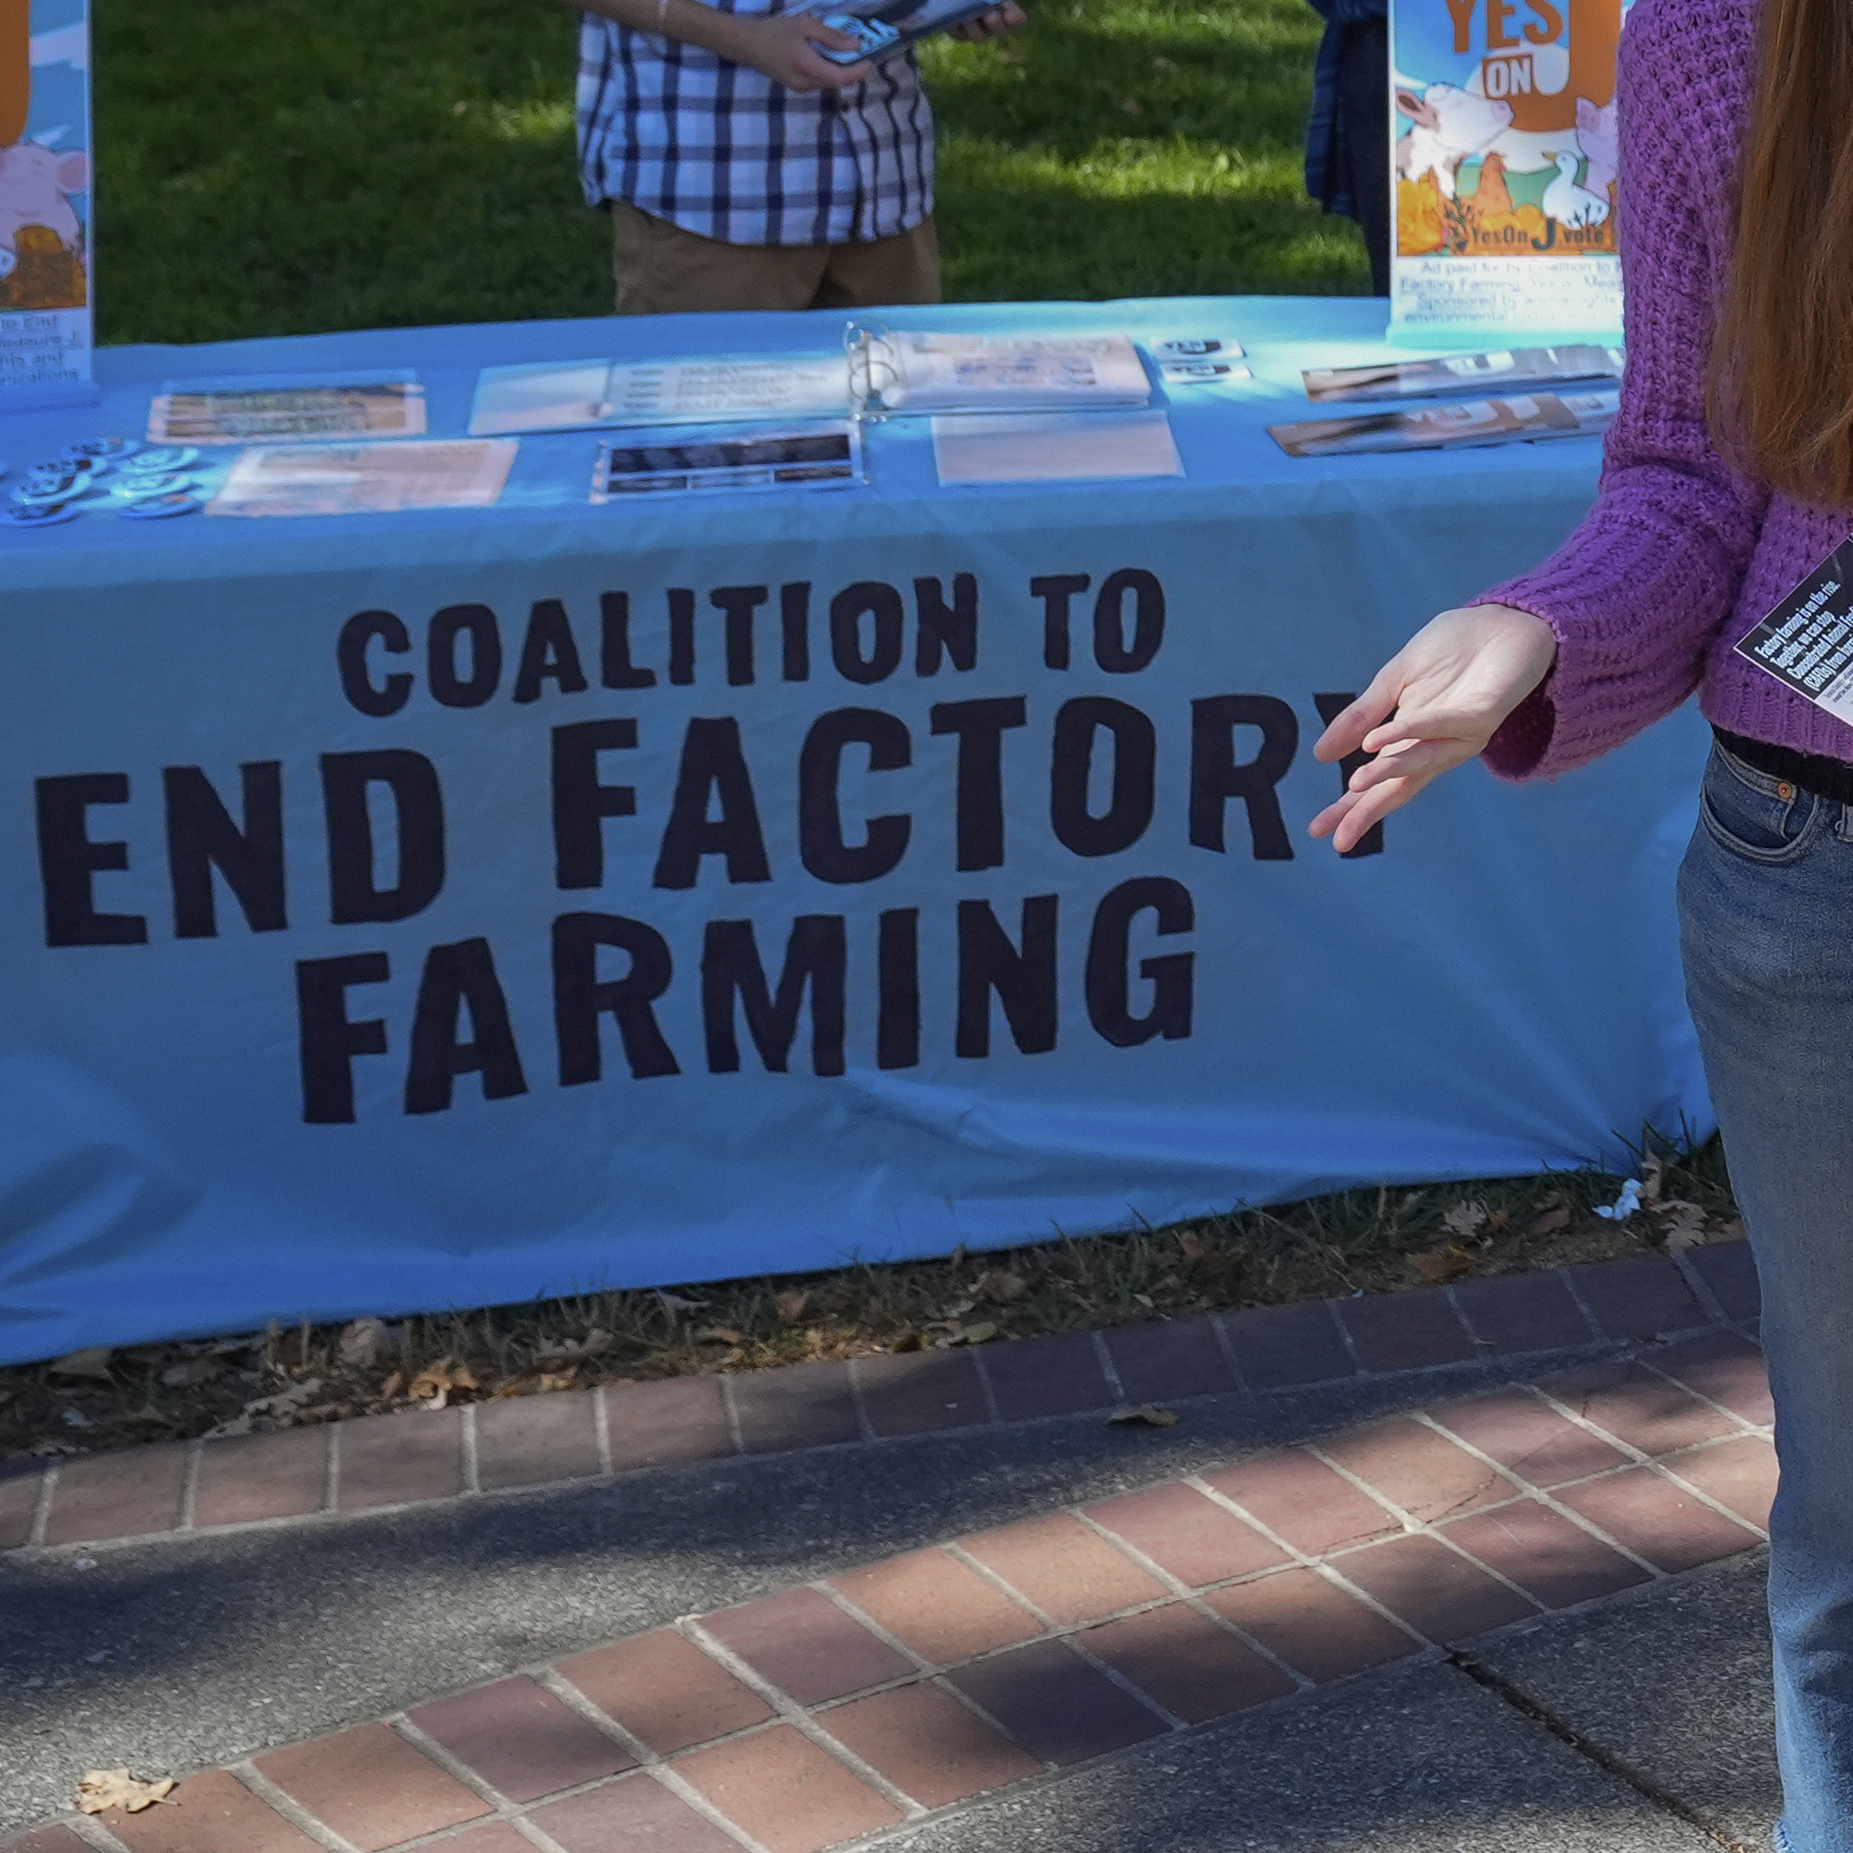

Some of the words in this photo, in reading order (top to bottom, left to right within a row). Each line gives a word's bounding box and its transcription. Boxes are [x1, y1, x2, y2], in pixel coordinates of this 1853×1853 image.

[1487, 58, 1533, 99] ON
[337, 571, 978, 718] COALITION
[1030, 567, 1167, 674] TO
[1753, 633, 1787, 658] Factory
[35, 749, 447, 948] END
[295, 875, 1196, 1125] FARMING
